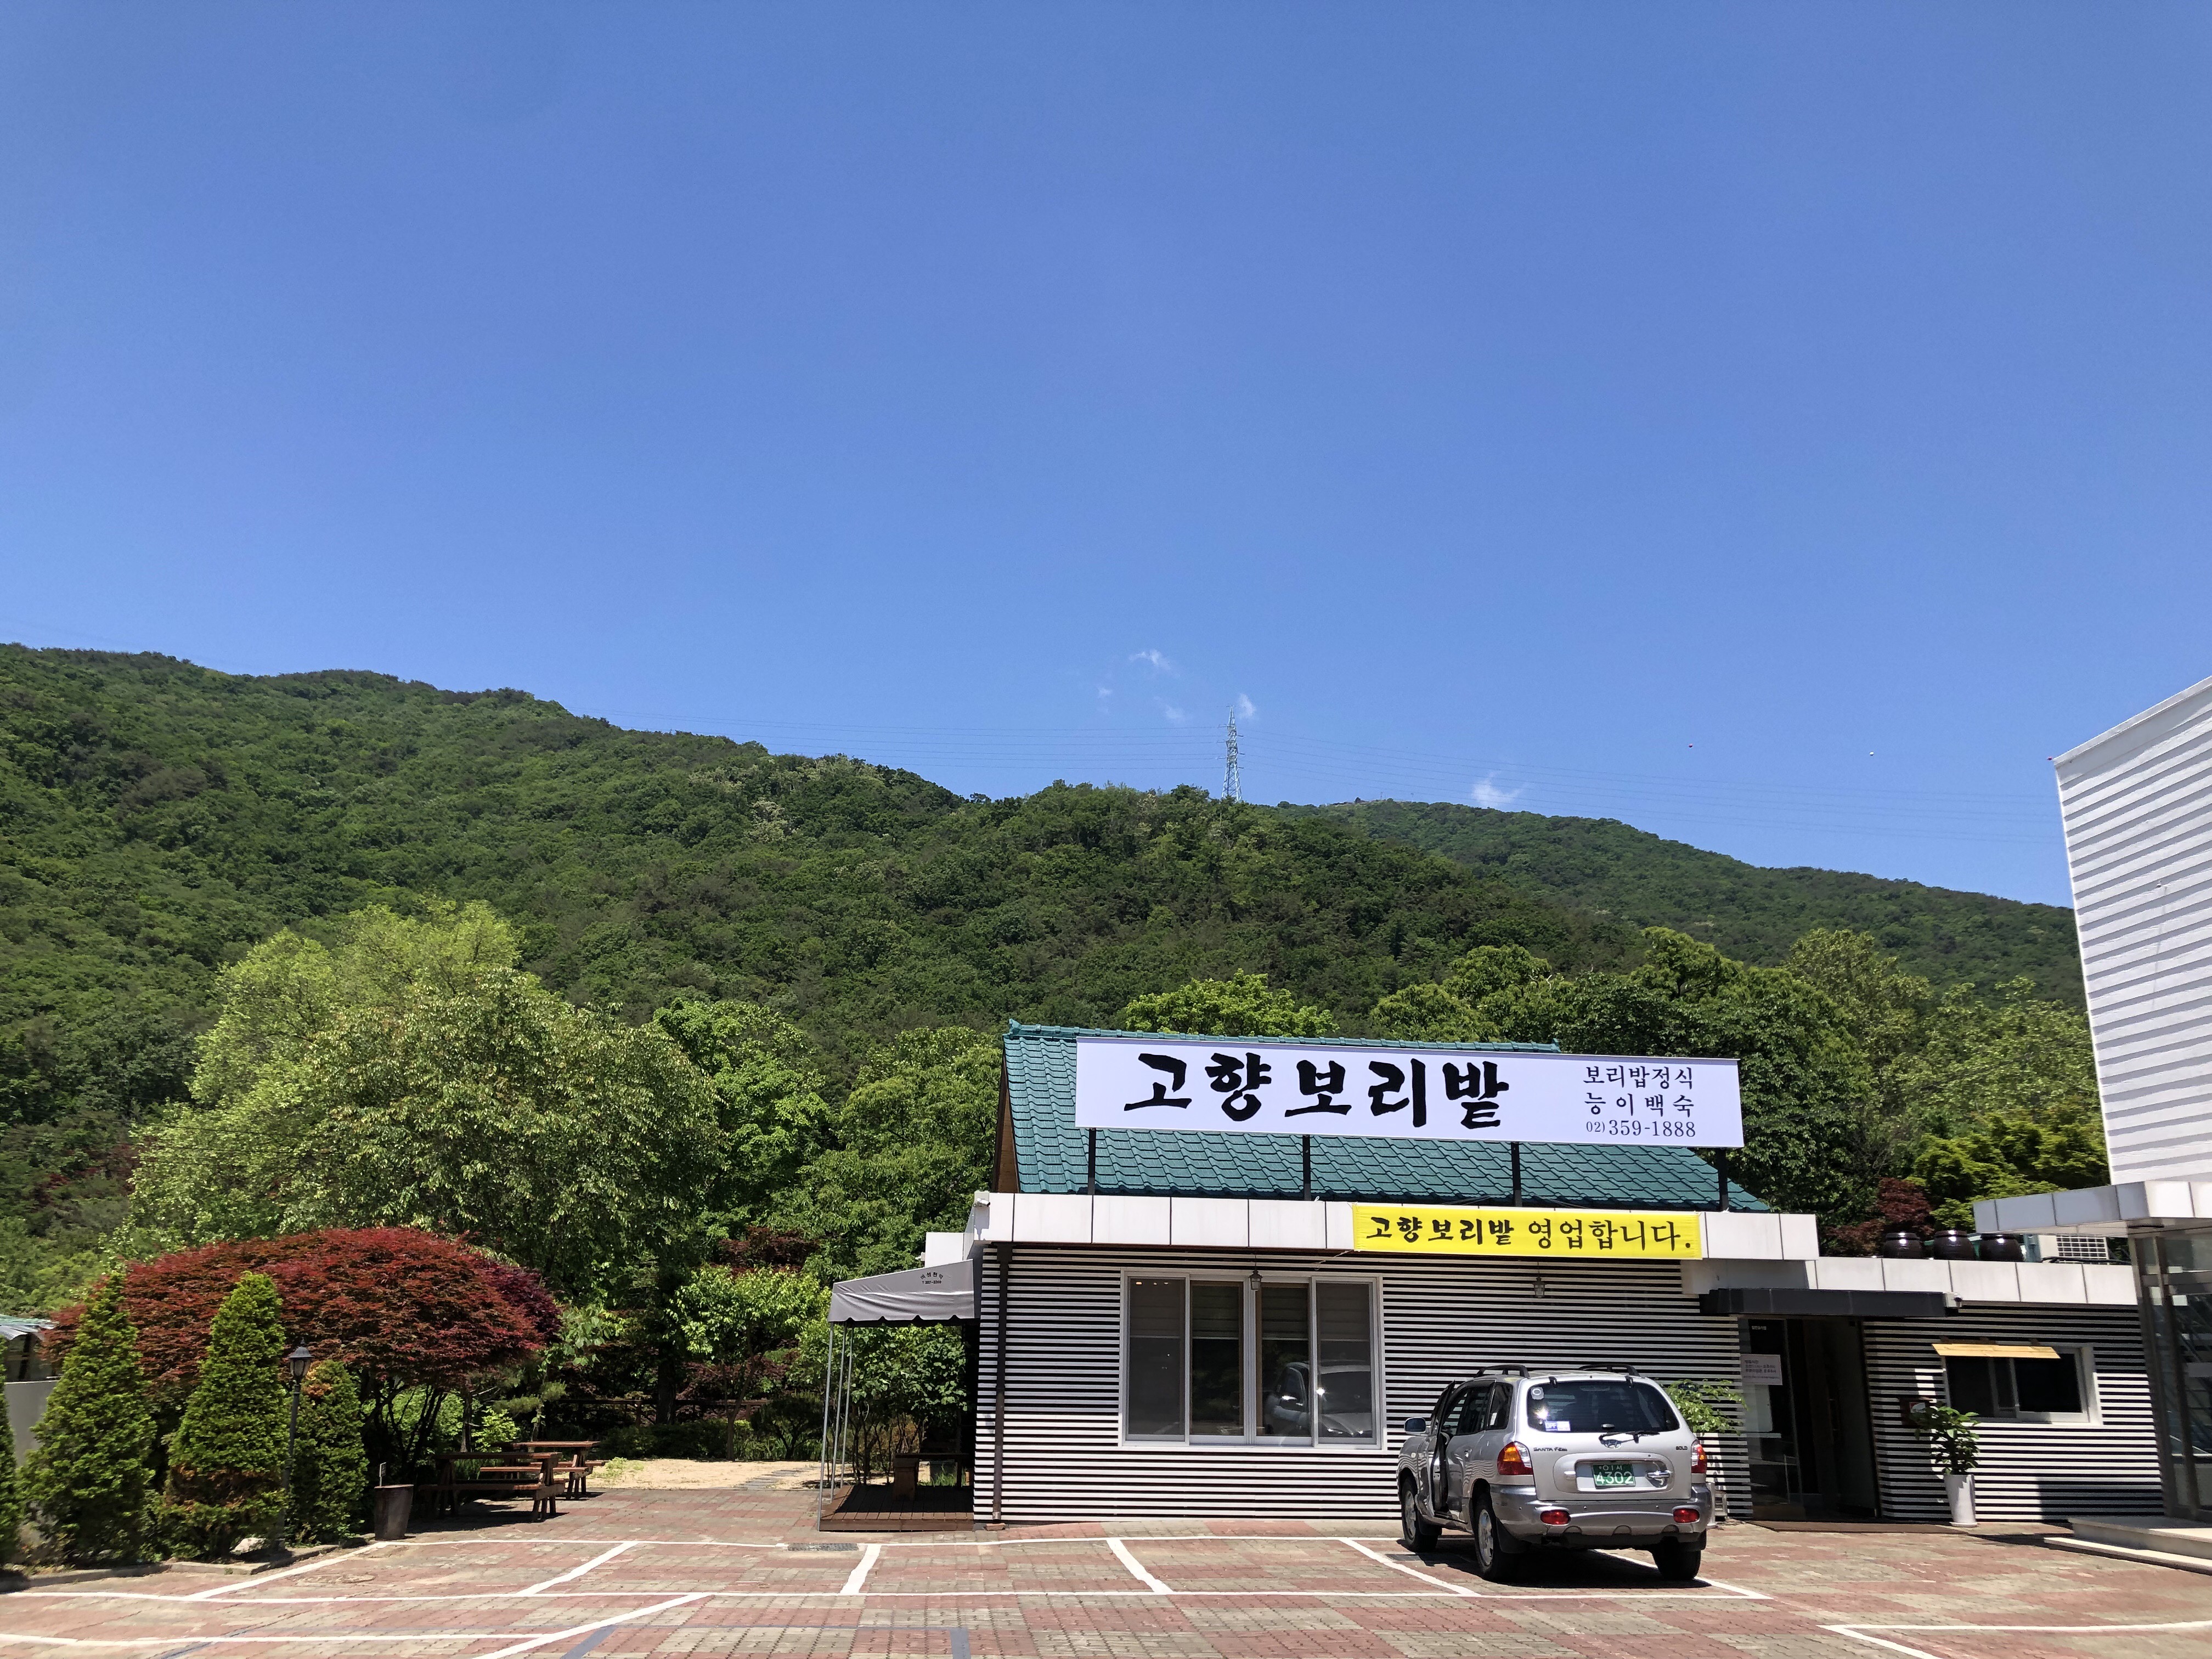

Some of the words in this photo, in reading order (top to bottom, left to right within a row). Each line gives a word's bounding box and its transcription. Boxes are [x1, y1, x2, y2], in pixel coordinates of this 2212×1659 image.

[1124, 1052, 1509, 1128] 고향보리밭
[1583, 1065, 1692, 1090] 보리밥정식
[1584, 1092, 1694, 1118] 능이백숙
[1366, 1216, 1514, 1245] 고향보리밭
[1528, 1218, 1691, 1251] 영업합니다.
[1596, 1471, 1634, 1484] 4302
